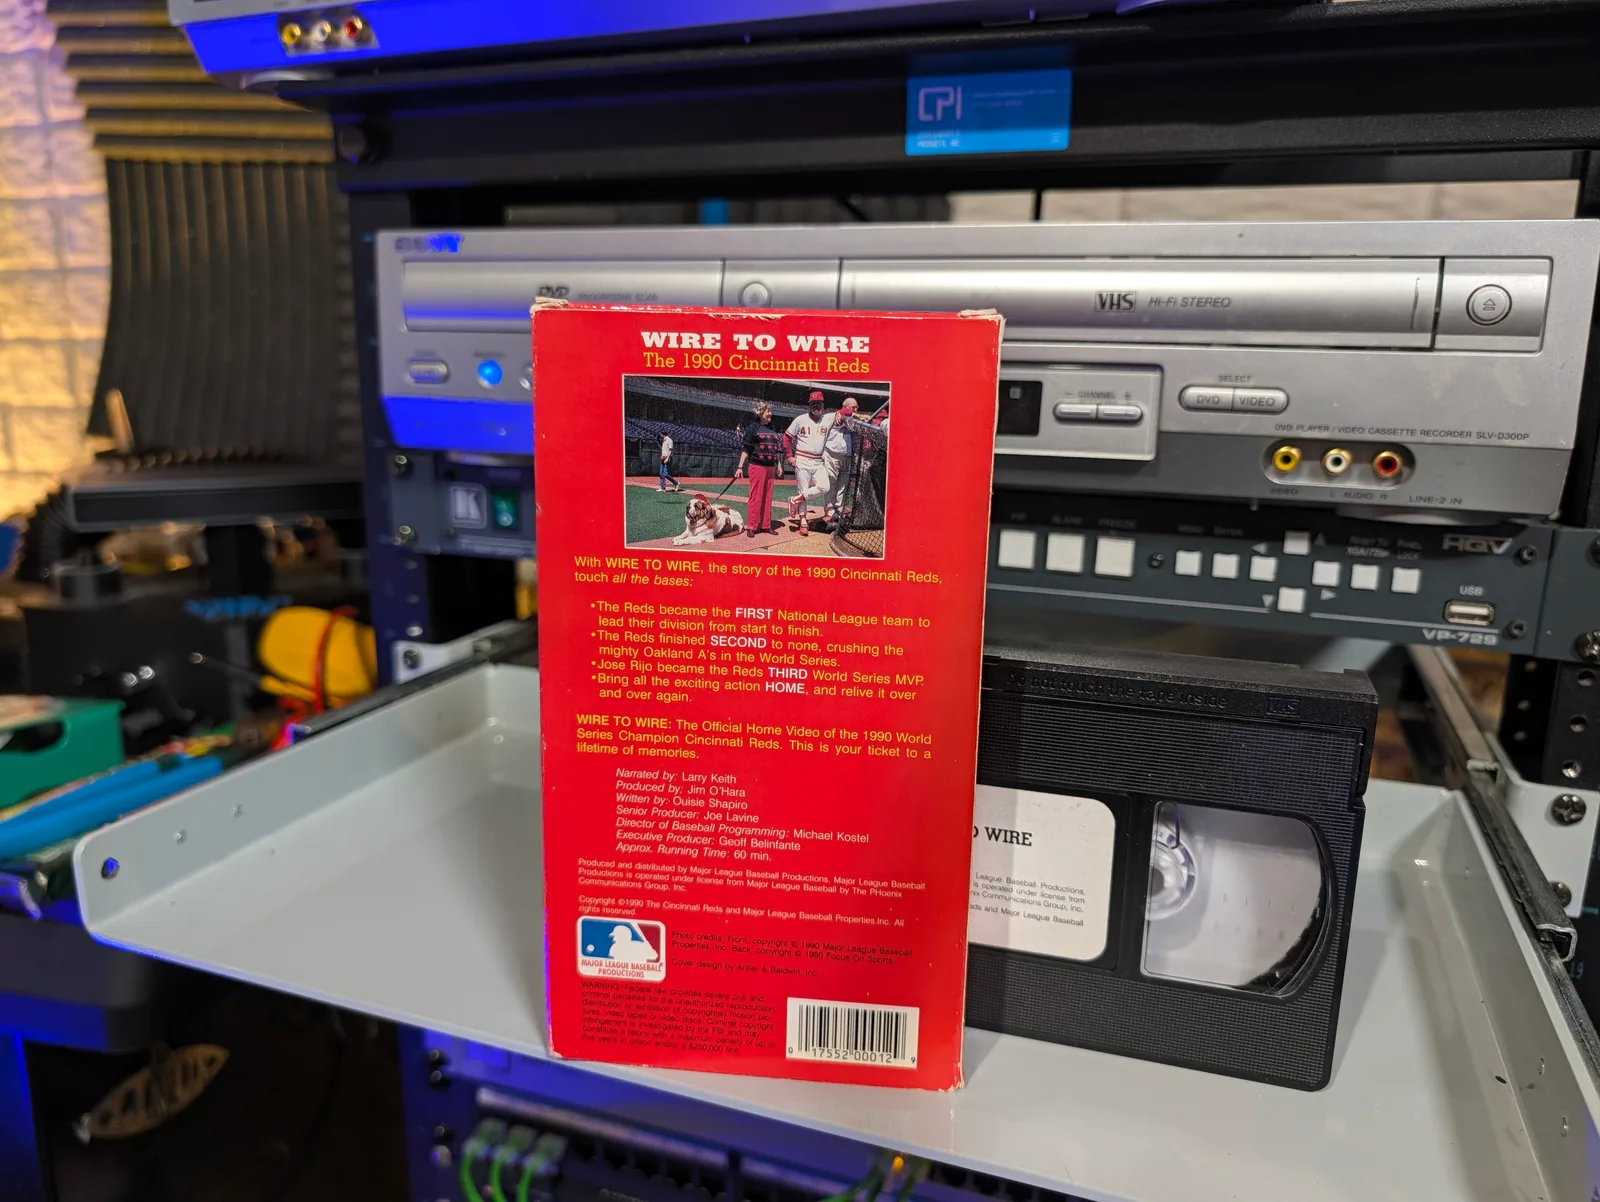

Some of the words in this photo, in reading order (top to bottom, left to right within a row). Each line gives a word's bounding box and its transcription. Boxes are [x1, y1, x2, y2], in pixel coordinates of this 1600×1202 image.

[1098, 292, 1135, 311] VHS
[1180, 296, 1232, 308] STEREO
[640, 331, 721, 349] WIRE
[733, 333, 776, 351] TO
[787, 335, 870, 353] WIRE
[643, 352, 675, 368] The
[684, 353, 722, 369] 1990
[729, 354, 819, 372] Cincinnati
[826, 357, 870, 373] Reds
[1196, 395, 1220, 405] DVD
[1239, 396, 1276, 407] VIDEO
[1368, 427, 1416, 437] CASSETTE
[1420, 430, 1472, 439] RECORDER
[1476, 431, 1530, 441] SLV-D300P
[1343, 491, 1373, 500] AUDIO
[1408, 495, 1447, 505] LINE-2
[1450, 497, 1463, 505] IN
[1442, 534, 1512, 554] HQV
[574, 556, 601, 567] With
[605, 557, 639, 569] WIRE
[643, 559, 662, 570] TO
[666, 560, 704, 574] WIRE,
[708, 562, 727, 574] the
[732, 564, 762, 578] story
[766, 565, 778, 576] of
[782, 565, 801, 577] the
[807, 567, 836, 579] 1990
[840, 568, 902, 581] Cincinnati
[907, 570, 942, 585] Reds,
[574, 571, 608, 582] touch
[612, 573, 627, 583] all
[631, 574, 649, 584] the
[654, 574, 693, 587] bases:
[1460, 585, 1484, 597] USB
[596, 600, 619, 612] The
[624, 602, 655, 614] Reds
[659, 604, 707, 617] became
[712, 606, 731, 618] the
[735, 607, 773, 619] FIRST
[778, 609, 827, 622] National
[832, 612, 878, 627] League
[882, 615, 913, 627] team
[918, 617, 931, 628] to
[598, 615, 624, 627] lead
[628, 617, 655, 628] their
[659, 618, 704, 631] division
[709, 620, 736, 632] from
[741, 623, 767, 634] start
[771, 624, 783, 635] to
[788, 624, 823, 637] finish.
[597, 629, 620, 641] The
[624, 631, 655, 643] Reds
[659, 632, 705, 645] finished
[710, 635, 767, 648] SECOND
[771, 639, 783, 649] to
[788, 641, 821, 652] none,
[826, 642, 879, 657] crushing
[884, 644, 904, 656] the
[616, 768, 659, 779] Narrated
[662, 770, 678, 782] by:
[682, 772, 707, 784] Larry
[711, 773, 737, 784] Keith
[616, 780, 665, 792] Produced
[668, 783, 683, 795] by:
[687, 785, 706, 794] Jim
[709, 785, 746, 797] O'Hara
[616, 793, 650, 803] Written
[653, 795, 668, 806] by:
[709, 798, 748, 811] Shapiro
[616, 804, 648, 816] Senior
[651, 807, 699, 819] Producer:
[704, 810, 722, 821] Joe
[726, 812, 759, 823] Lavine
[616, 817, 656, 828] Director
[658, 820, 669, 829] of
[672, 820, 715, 832] Baseball
[718, 823, 789, 839] Programming:
[793, 828, 833, 840] Michael
[837, 832, 869, 843] Kostel
[984, 826, 1032, 846] WIRE
[616, 829, 663, 841] Executive
[666, 832, 715, 845] Producer:
[719, 836, 747, 847] Geoff
[751, 838, 801, 851] Belinfante
[616, 841, 653, 853] Approx.
[657, 844, 699, 858] Running
[704, 847, 729, 858] Time:
[734, 849, 747, 859] 60
[750, 852, 771, 861] min.
[976, 872, 1002, 883] League
[578, 895, 615, 906] Copyright
[982, 883, 1013, 893] operated
[1041, 891, 1065, 900] license
[1069, 895, 1085, 904] from
[982, 890, 1041, 906] Communications
[1070, 904, 1084, 913] Inc.
[1001, 907, 1020, 917] Major
[1023, 911, 1050, 922] League
[1053, 916, 1084, 926] Baseball
[581, 958, 603, 967] MAJOR
[605, 960, 629, 970] LEAGUE
[598, 967, 644, 978] PRODUCTIONS
[812, 1048, 848, 1060] 17552
[854, 1050, 892, 1063] 00012
